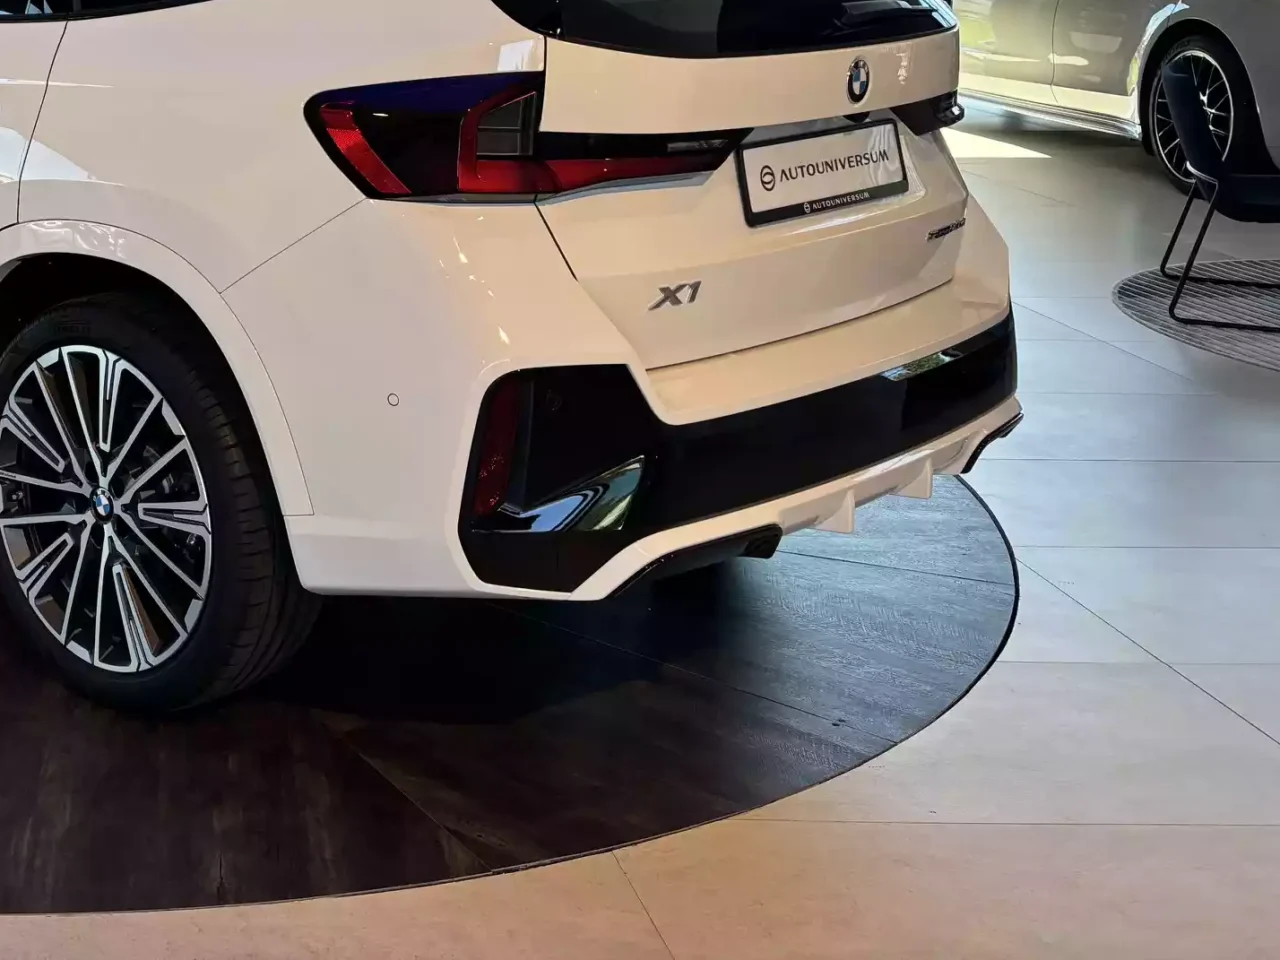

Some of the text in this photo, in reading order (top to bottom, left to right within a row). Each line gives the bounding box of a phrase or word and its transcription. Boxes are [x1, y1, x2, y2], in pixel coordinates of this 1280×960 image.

[779, 149, 889, 182] AUTOUNIVERSUM
[812, 191, 870, 210] AUTOUNIVERSUM
[648, 280, 702, 311] X1
